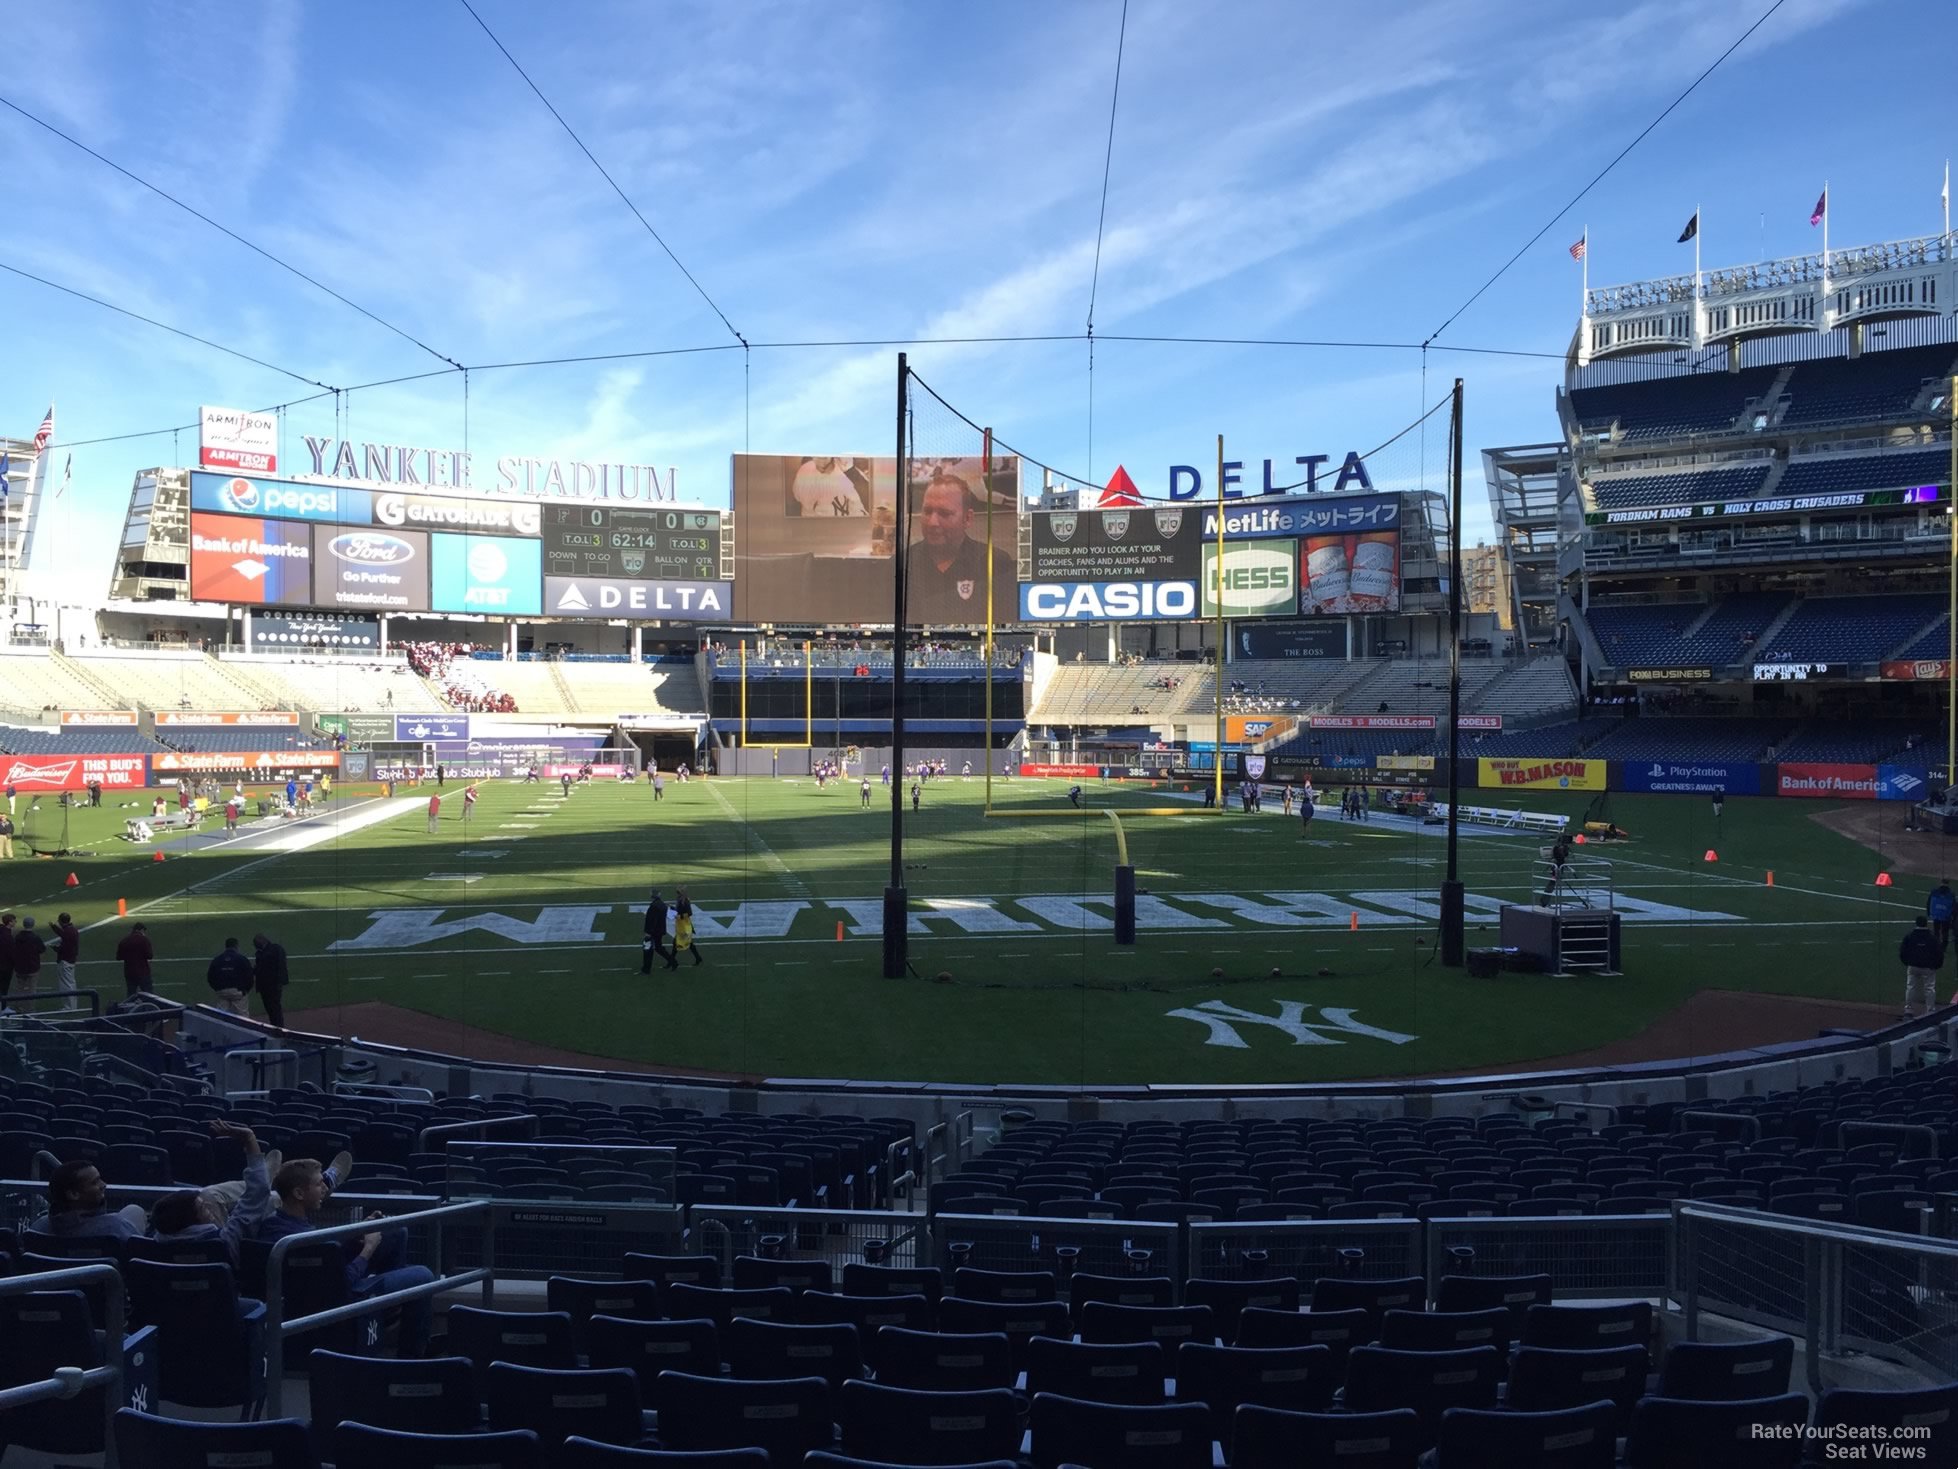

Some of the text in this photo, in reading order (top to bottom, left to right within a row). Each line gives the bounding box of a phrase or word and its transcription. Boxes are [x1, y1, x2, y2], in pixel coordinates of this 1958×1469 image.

[305, 436, 678, 502] YANKEE STADIUM
[1170, 450, 1374, 504] DELTA
[265, 487, 337, 514] pepsi
[408, 503, 510, 525] GATORADE
[1607, 510, 1657, 522] FORDHAM
[1660, 507, 1692, 518] RAMS
[1724, 502, 1750, 514] HOLY
[1754, 499, 1791, 512] CROSS
[1794, 495, 1864, 509] CRUSADERS
[591, 510, 602, 526] 0
[666, 513, 677, 529] 0
[1205, 505, 1398, 534] MetLife メットライフ
[593, 535, 600, 545] 3
[612, 534, 655, 547] 62:14
[698, 539, 706, 548] 3
[193, 535, 309, 558] Bank of America
[346, 537, 398, 561] Ford
[1108, 546, 1126, 554] LOOK
[1039, 559, 1074, 567] COACHES,
[1115, 557, 1139, 565] ALUMS
[343, 571, 401, 585] Go Further
[1211, 566, 1288, 591] HESS
[464, 588, 512, 604] AT&T
[600, 585, 721, 611] DELTA
[1027, 583, 1195, 618] CASIO
[1303, 648, 1324, 656] BOSS
[1652, 670, 1711, 678] BUSINESS
[1754, 672, 1775, 680] PLAY
[83, 713, 131, 723] State Farm
[179, 715, 222, 723] State Farm
[249, 715, 290, 723] State Farm
[1369, 718, 1431, 726] MODELLS.com
[1245, 723, 1271, 736] SAP
[1143, 742, 1168, 751] FedEx
[83, 759, 143, 770] THIS BUD'S
[181, 755, 244, 767] State Farm
[275, 754, 334, 765] State Farm
[1343, 756, 1366, 766] pepsi
[1490, 760, 1520, 770] WHO BUT
[8, 766, 70, 778] Budweiser
[83, 772, 131, 784] FOR YOU.
[461, 768, 501, 777] StubHub
[1669, 766, 1727, 778] PlayStation
[1651, 783, 1725, 792] GREATNESS AWAITS
[1782, 776, 1887, 791] Bank of America
